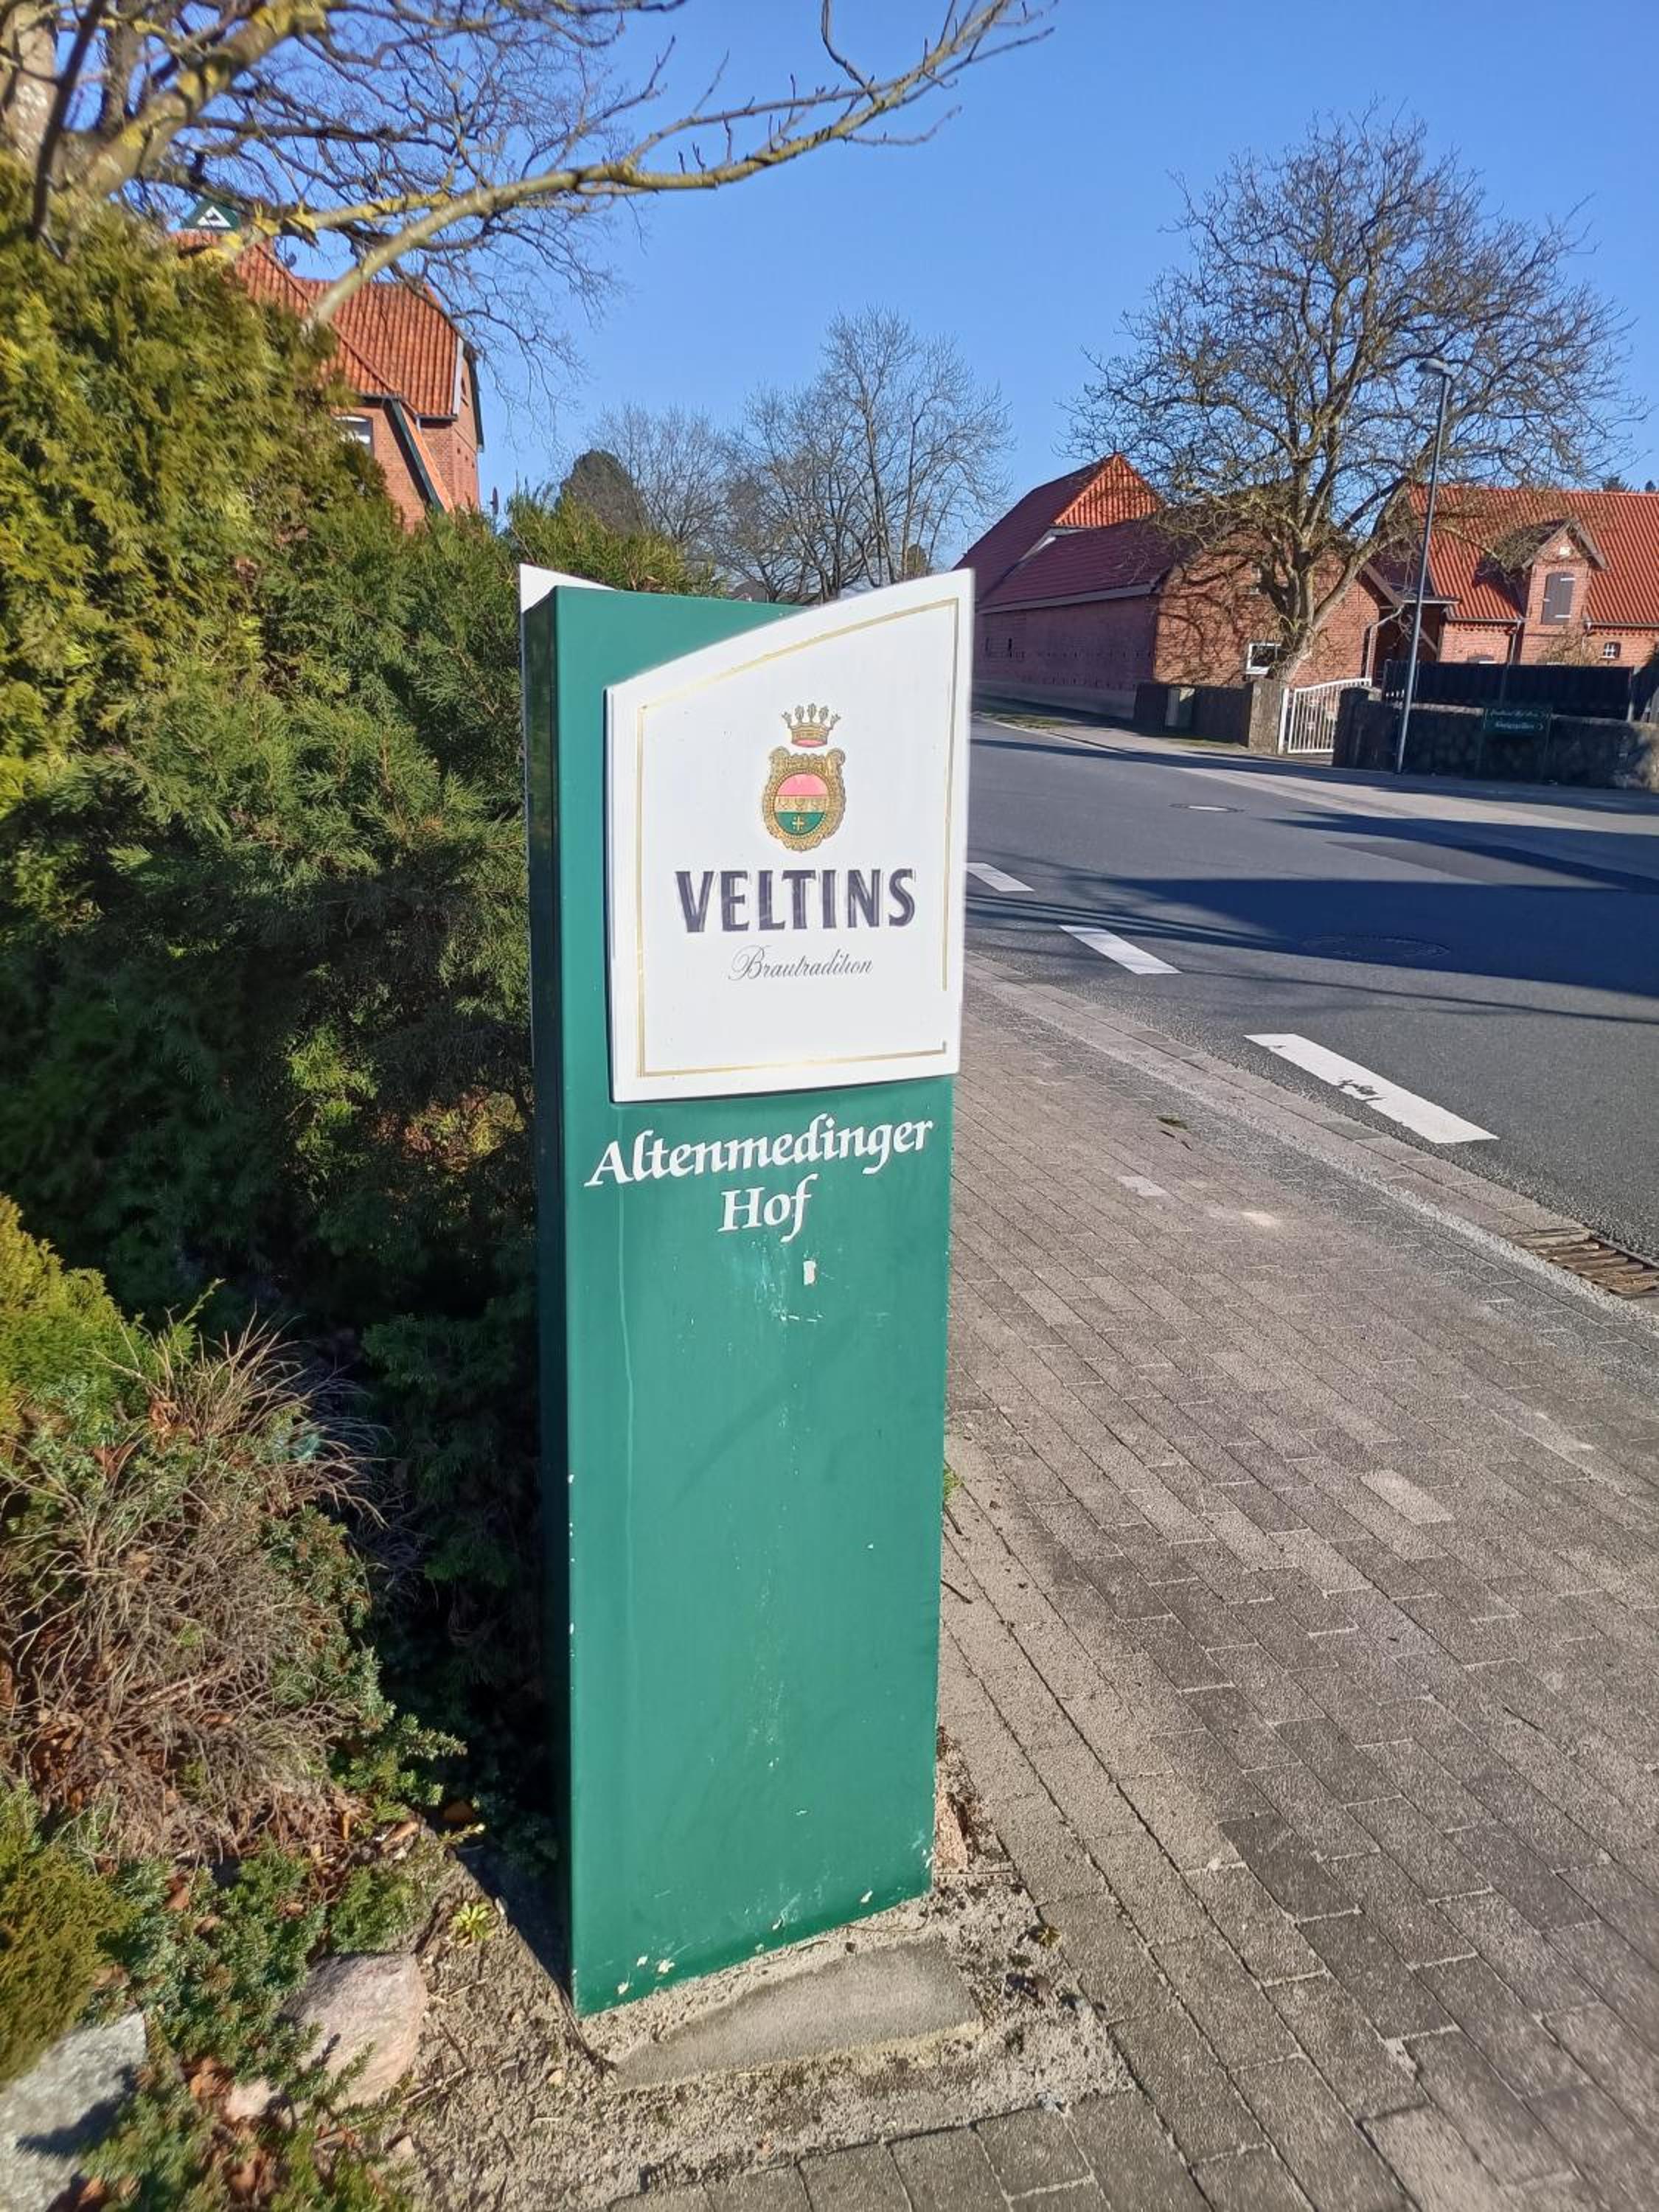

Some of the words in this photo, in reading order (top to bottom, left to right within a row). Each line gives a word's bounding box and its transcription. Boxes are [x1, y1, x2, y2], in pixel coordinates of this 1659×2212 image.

[675, 868, 916, 933] VELTINS
[728, 945, 873, 981] Brautradition
[584, 1113, 933, 1187] Altenmedinger
[717, 1173, 818, 1242] Hof
